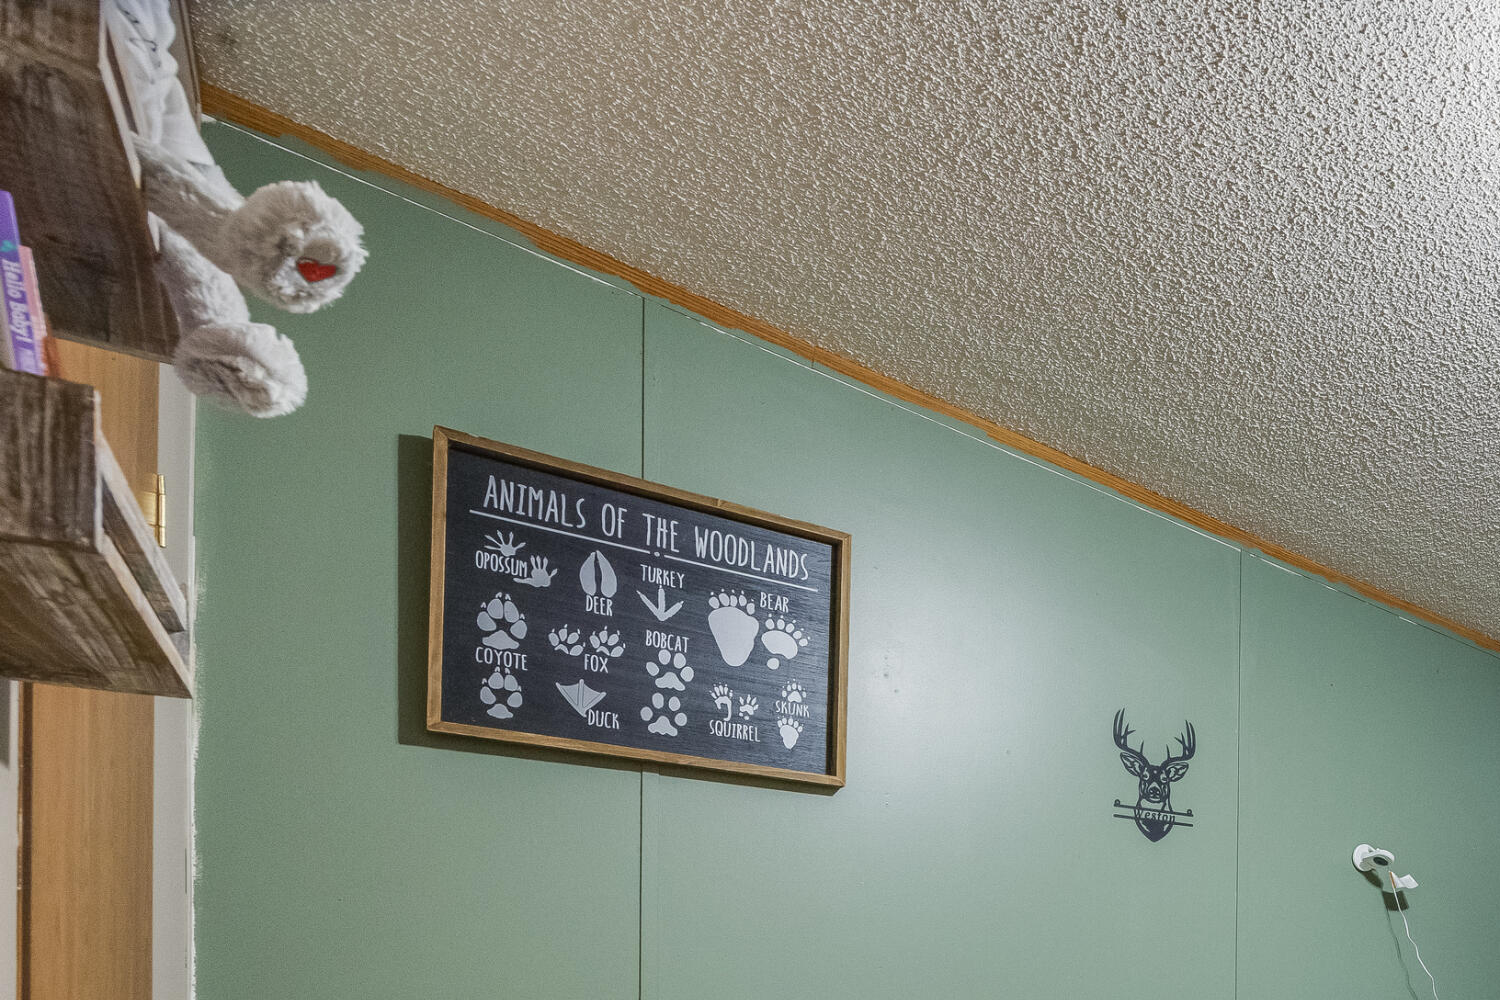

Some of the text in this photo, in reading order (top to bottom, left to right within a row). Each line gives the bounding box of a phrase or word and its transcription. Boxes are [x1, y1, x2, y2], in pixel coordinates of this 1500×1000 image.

[2, 258, 26, 298] Hello
[483, 475, 809, 581] ANIMALS OF THE WOODLANDS
[475, 550, 528, 578] OPOSSUM
[640, 564, 685, 589] TURKEY
[585, 595, 613, 617] DEER
[759, 591, 790, 613] BEAR
[645, 629, 689, 653] BOBCAT
[475, 647, 528, 671] COYOTE
[584, 653, 609, 674] FOX
[587, 708, 620, 730] DUCK
[775, 700, 810, 718] SKUNK
[709, 719, 761, 742] SQUIRREL
